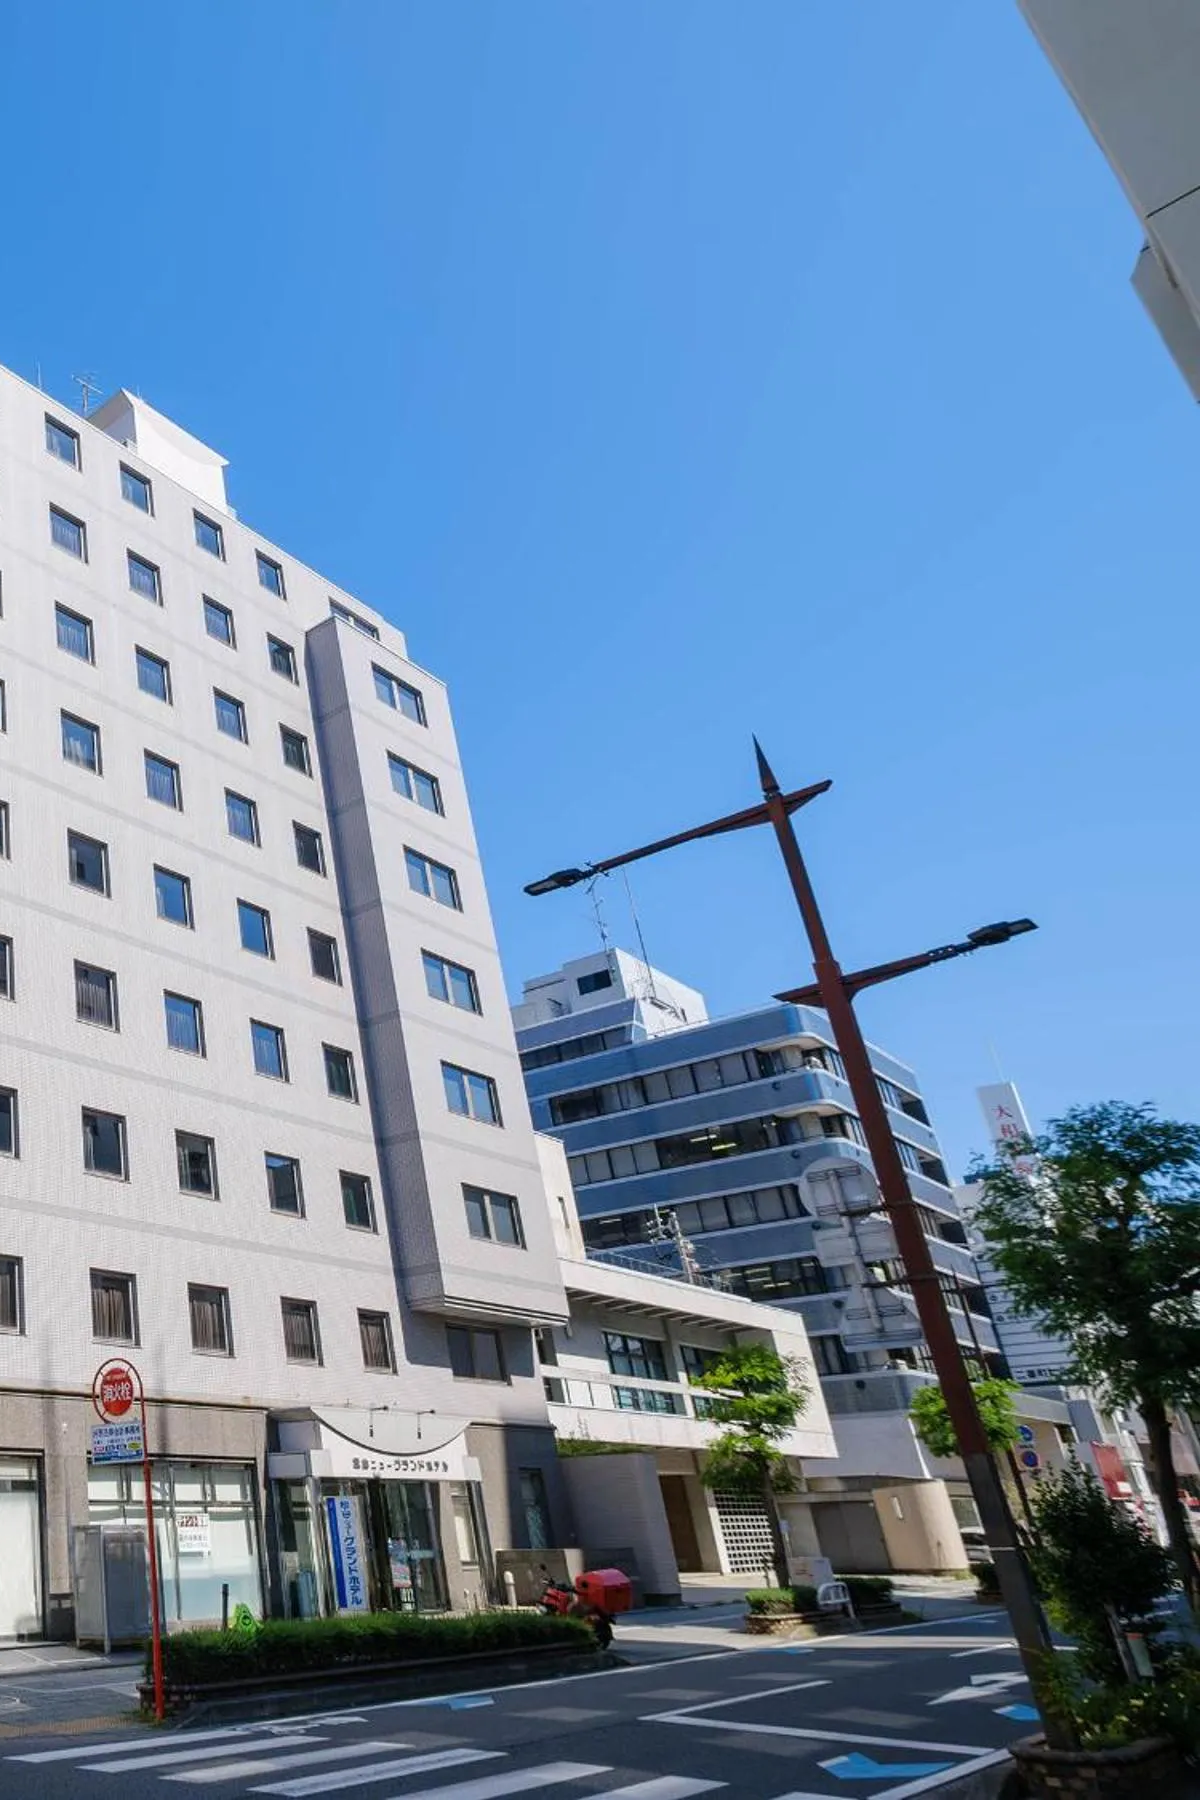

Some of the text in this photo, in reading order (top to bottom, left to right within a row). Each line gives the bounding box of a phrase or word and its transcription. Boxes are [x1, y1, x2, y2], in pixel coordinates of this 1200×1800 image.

[102, 1382, 132, 1402] 消火栓
[340, 1500, 362, 1605] 松山ニューグランドホテル
